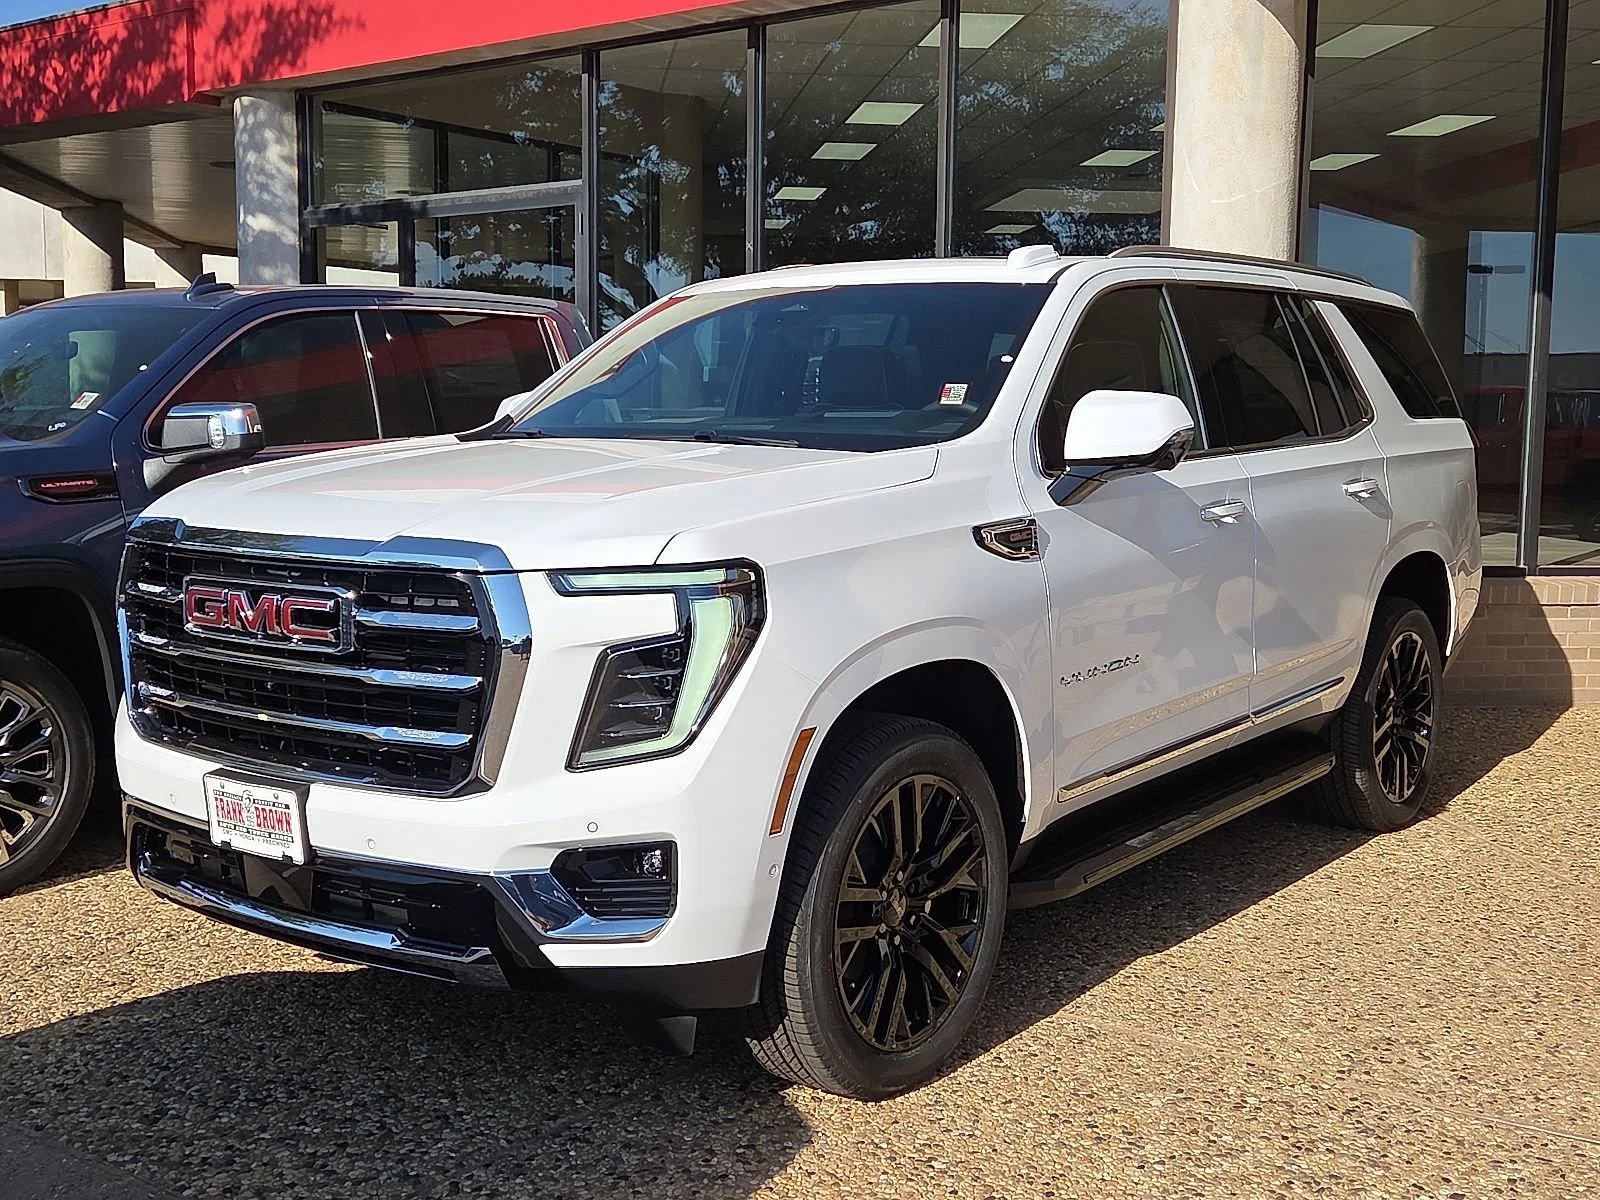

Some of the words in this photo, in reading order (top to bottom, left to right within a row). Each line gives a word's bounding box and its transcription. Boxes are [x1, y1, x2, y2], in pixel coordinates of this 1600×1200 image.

[40, 480, 95, 488] ULTIMATE
[185, 585, 336, 642] GMC
[214, 797, 246, 825] FRANK
[254, 806, 293, 833] BROWN
